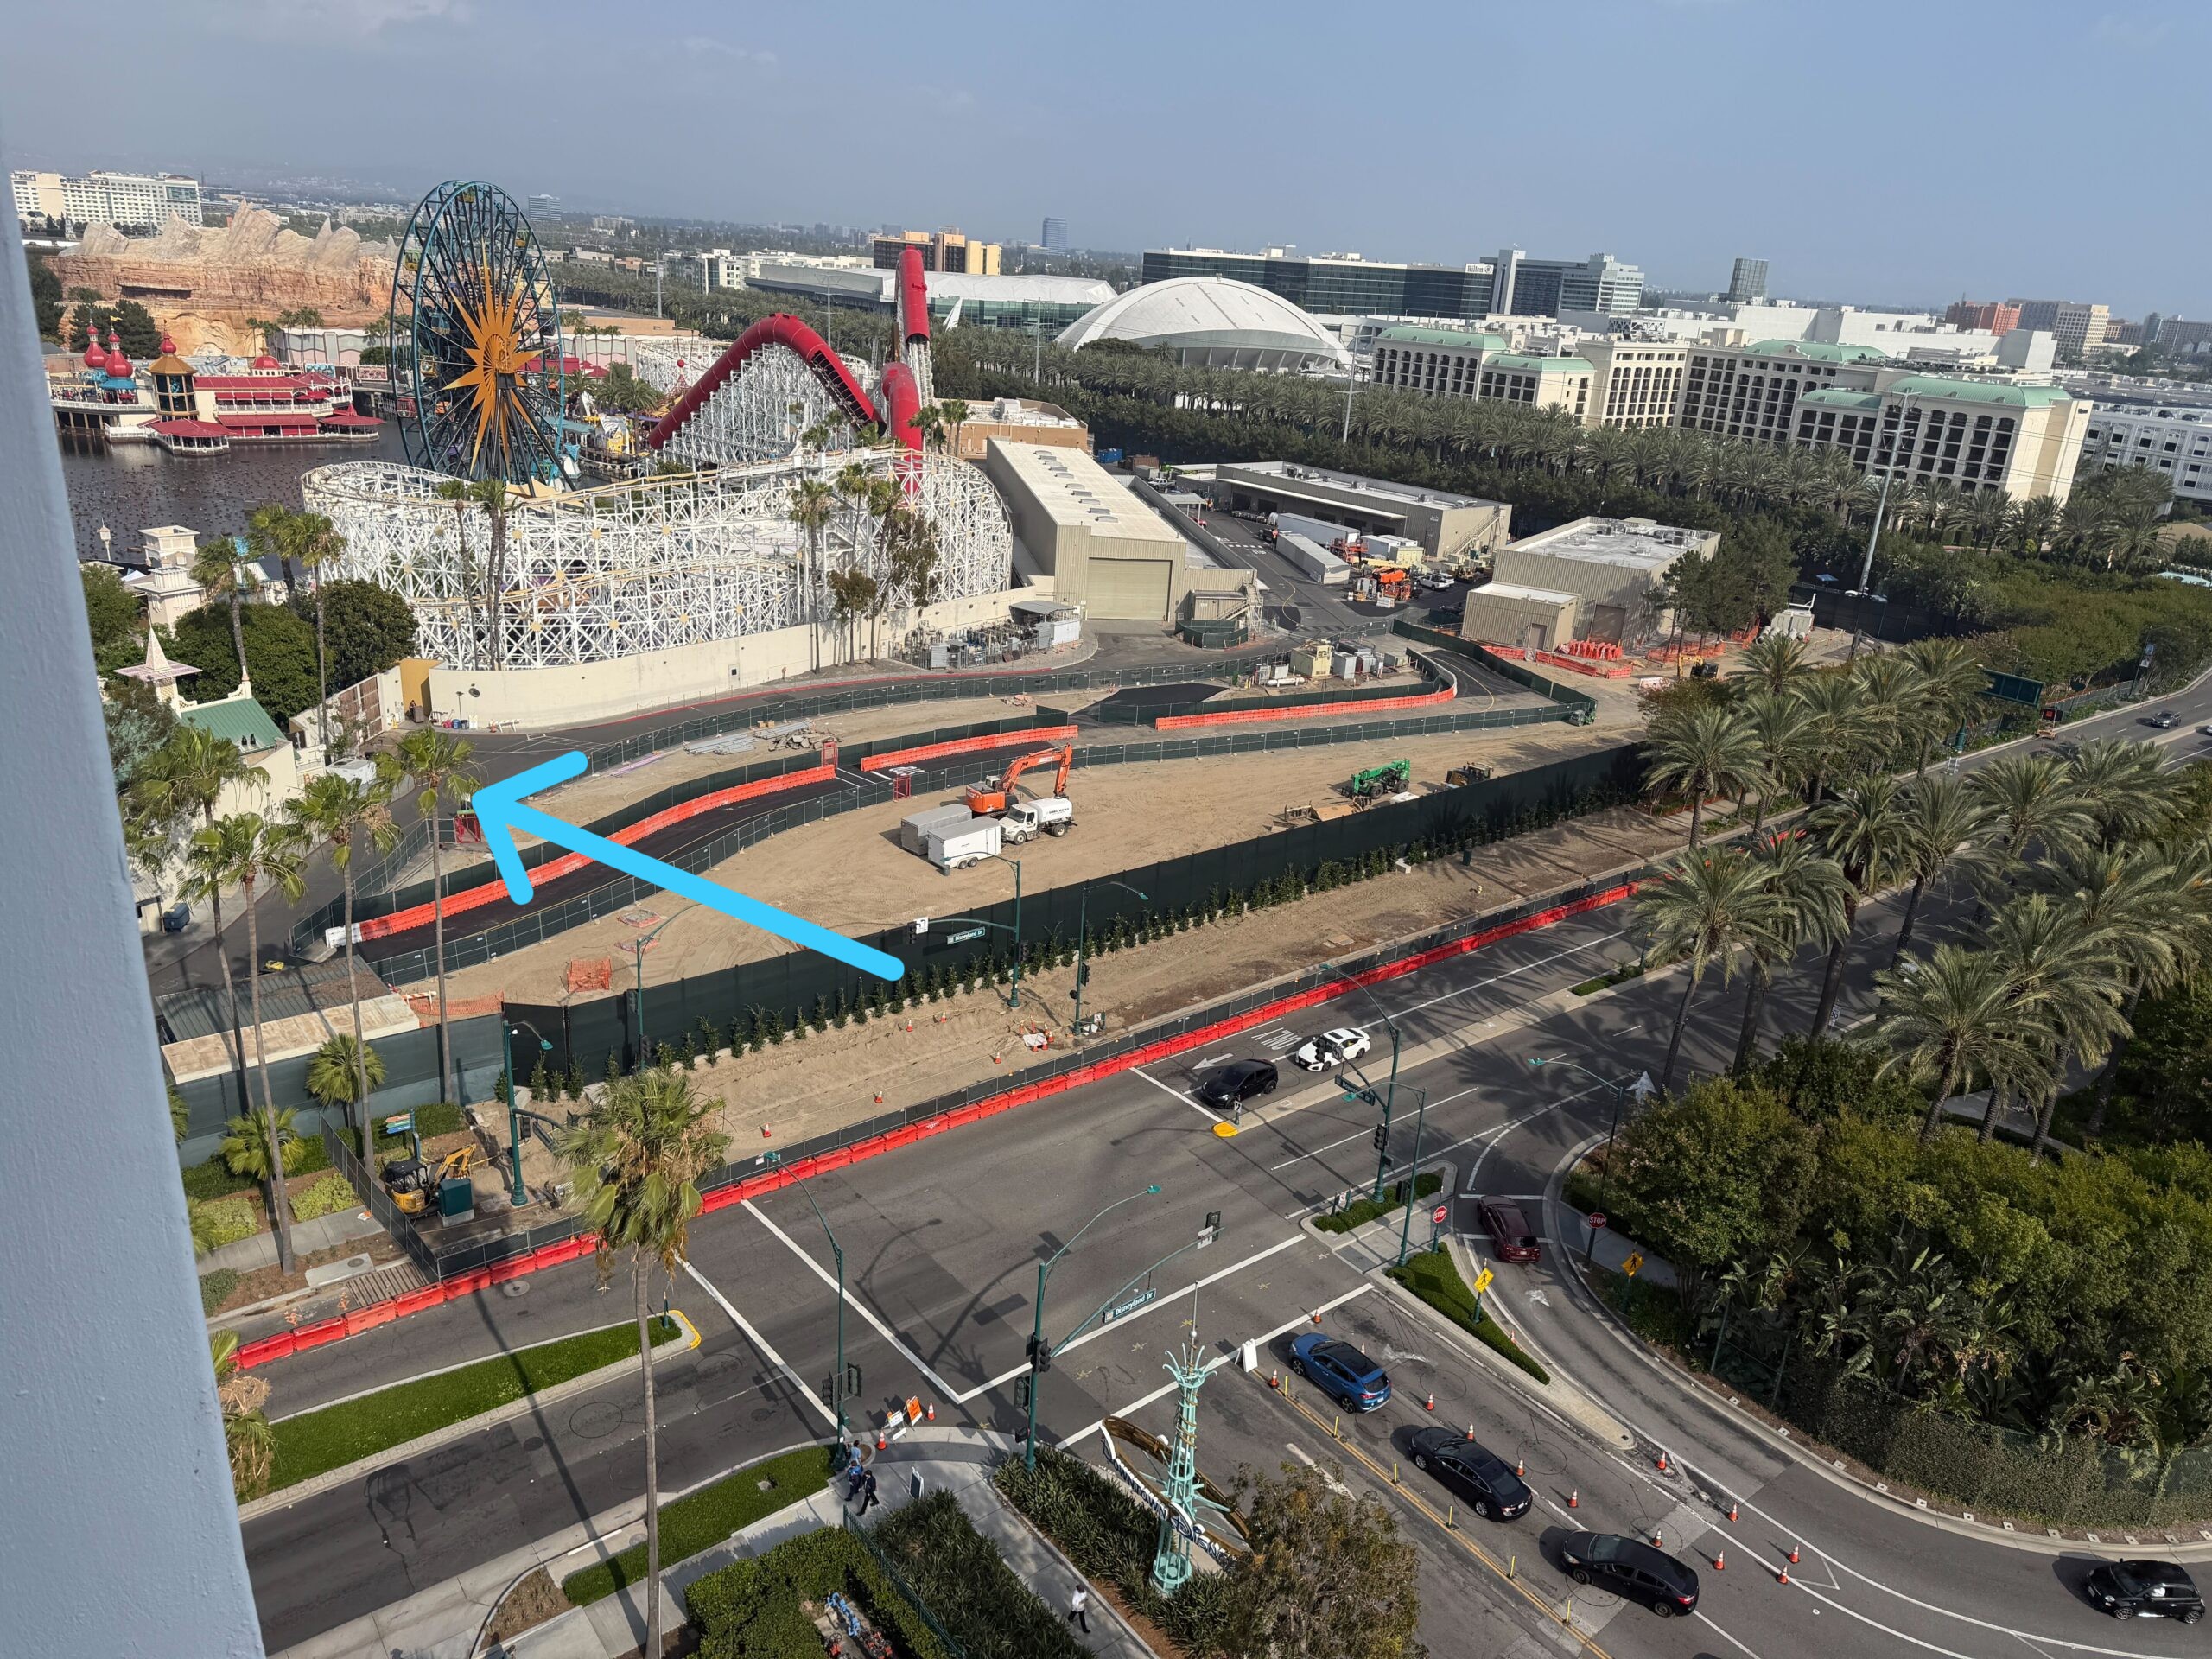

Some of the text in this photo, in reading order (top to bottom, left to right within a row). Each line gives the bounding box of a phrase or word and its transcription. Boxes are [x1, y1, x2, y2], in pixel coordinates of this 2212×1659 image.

[1467, 264, 1484, 273] Hilton
[1251, 1027, 1303, 1051] ONLY
[1434, 1210, 1447, 1219] STOP
[1115, 1292, 1154, 1316] Disneyland Dr
[1101, 1427, 1168, 1522] DOWNTOWN
